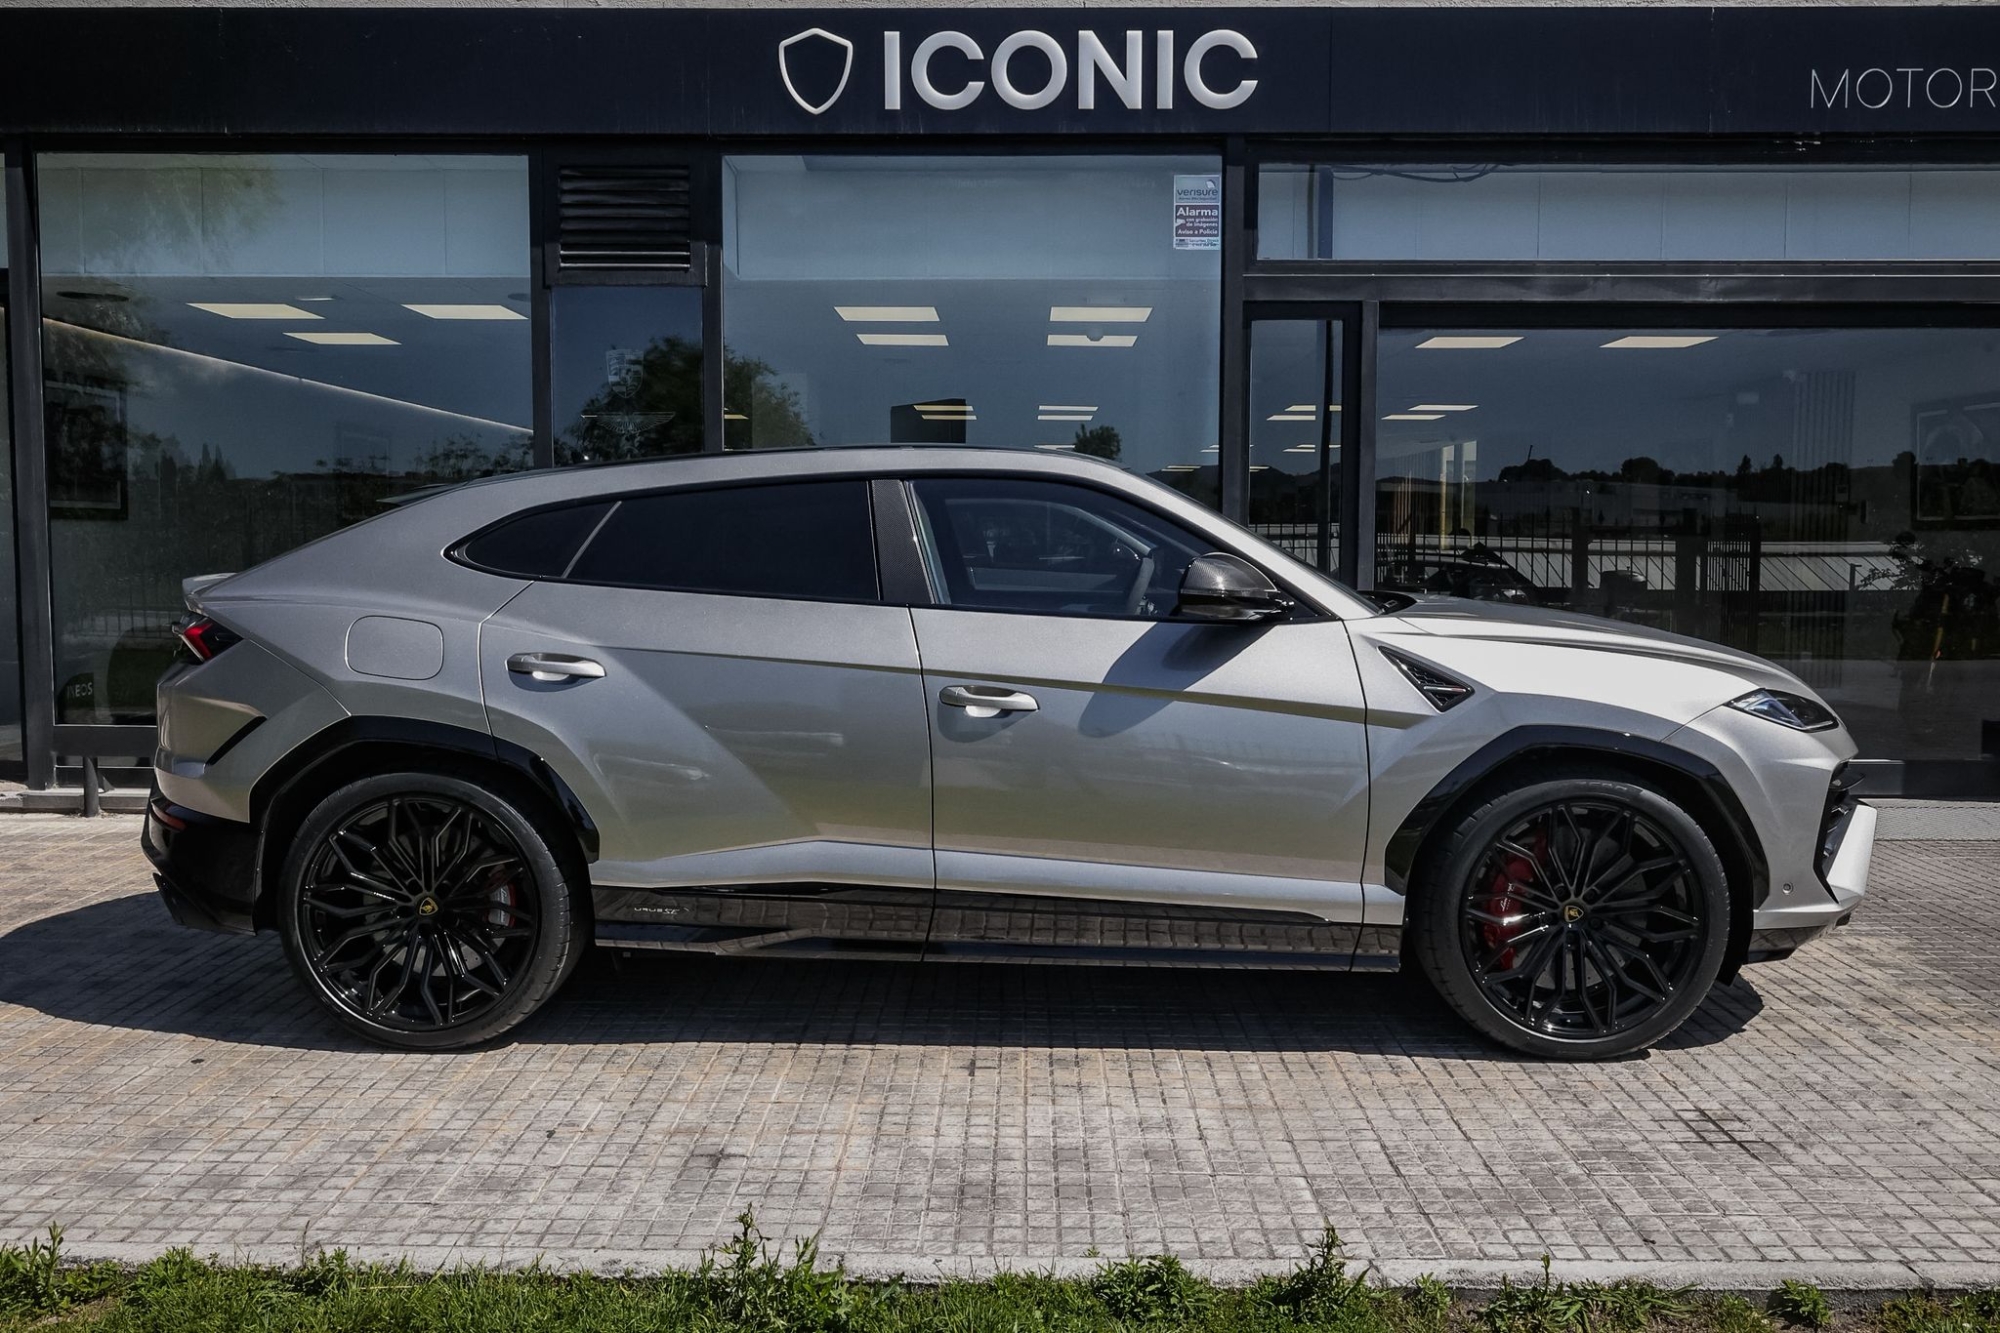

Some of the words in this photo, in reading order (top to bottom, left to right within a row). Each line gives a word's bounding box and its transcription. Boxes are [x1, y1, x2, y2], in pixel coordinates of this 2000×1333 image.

[884, 29, 1258, 110] ICONIC
[1810, 67, 1997, 109] MOTOR
[1177, 207, 1218, 216] Alarma
